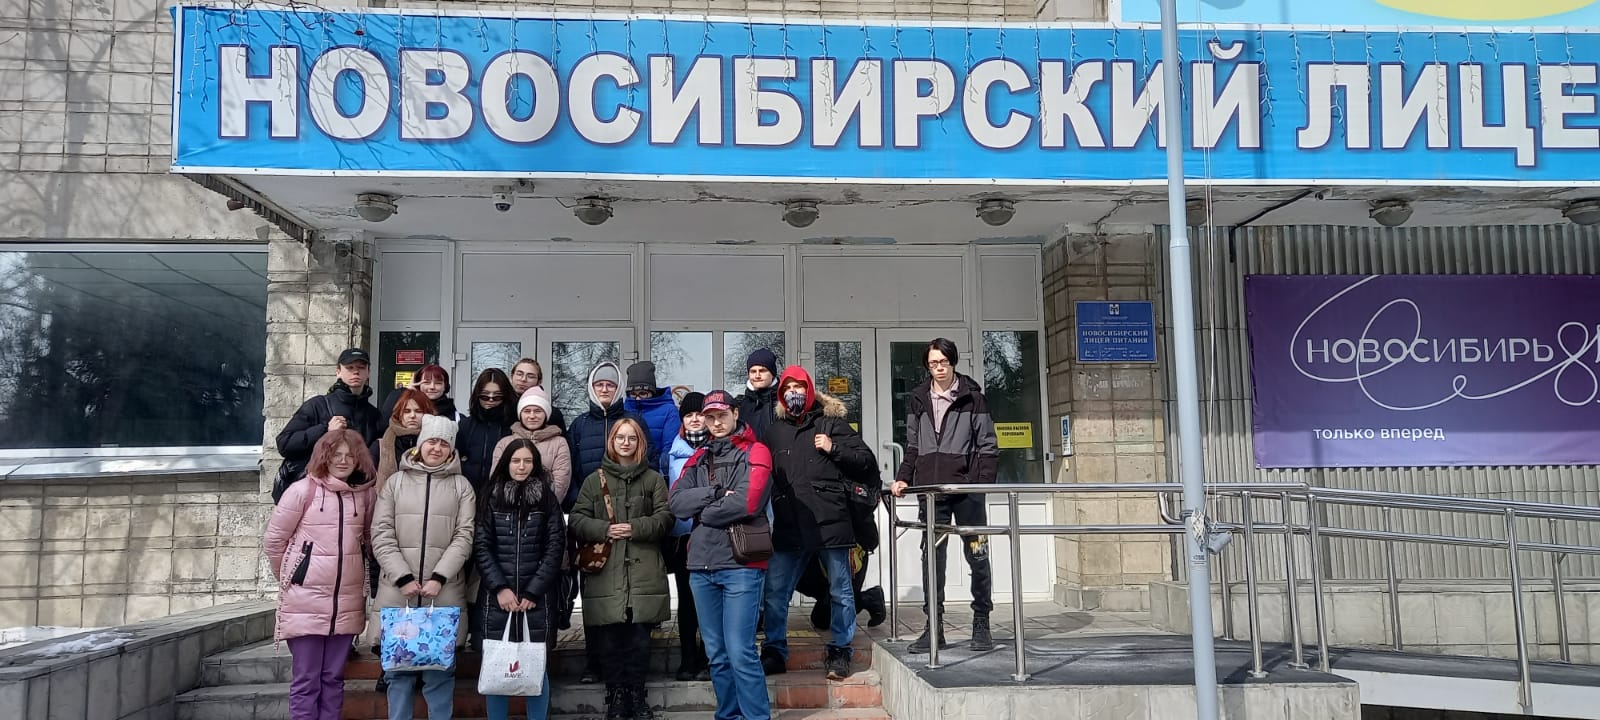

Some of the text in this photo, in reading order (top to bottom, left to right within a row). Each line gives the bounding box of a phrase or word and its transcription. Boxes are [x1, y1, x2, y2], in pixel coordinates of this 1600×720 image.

[218, 40, 1600, 168] НОВОСИБИРСКИЙ ЛИЦЕ
[1082, 329, 1149, 337] НОВОСИБИРСКИЙ
[1083, 336, 1148, 344] ЛИЦЕЙ ПИТАНИЯ
[1306, 337, 1554, 363] НОВОСИБИРЬ
[1313, 428, 1446, 442] только вперед
